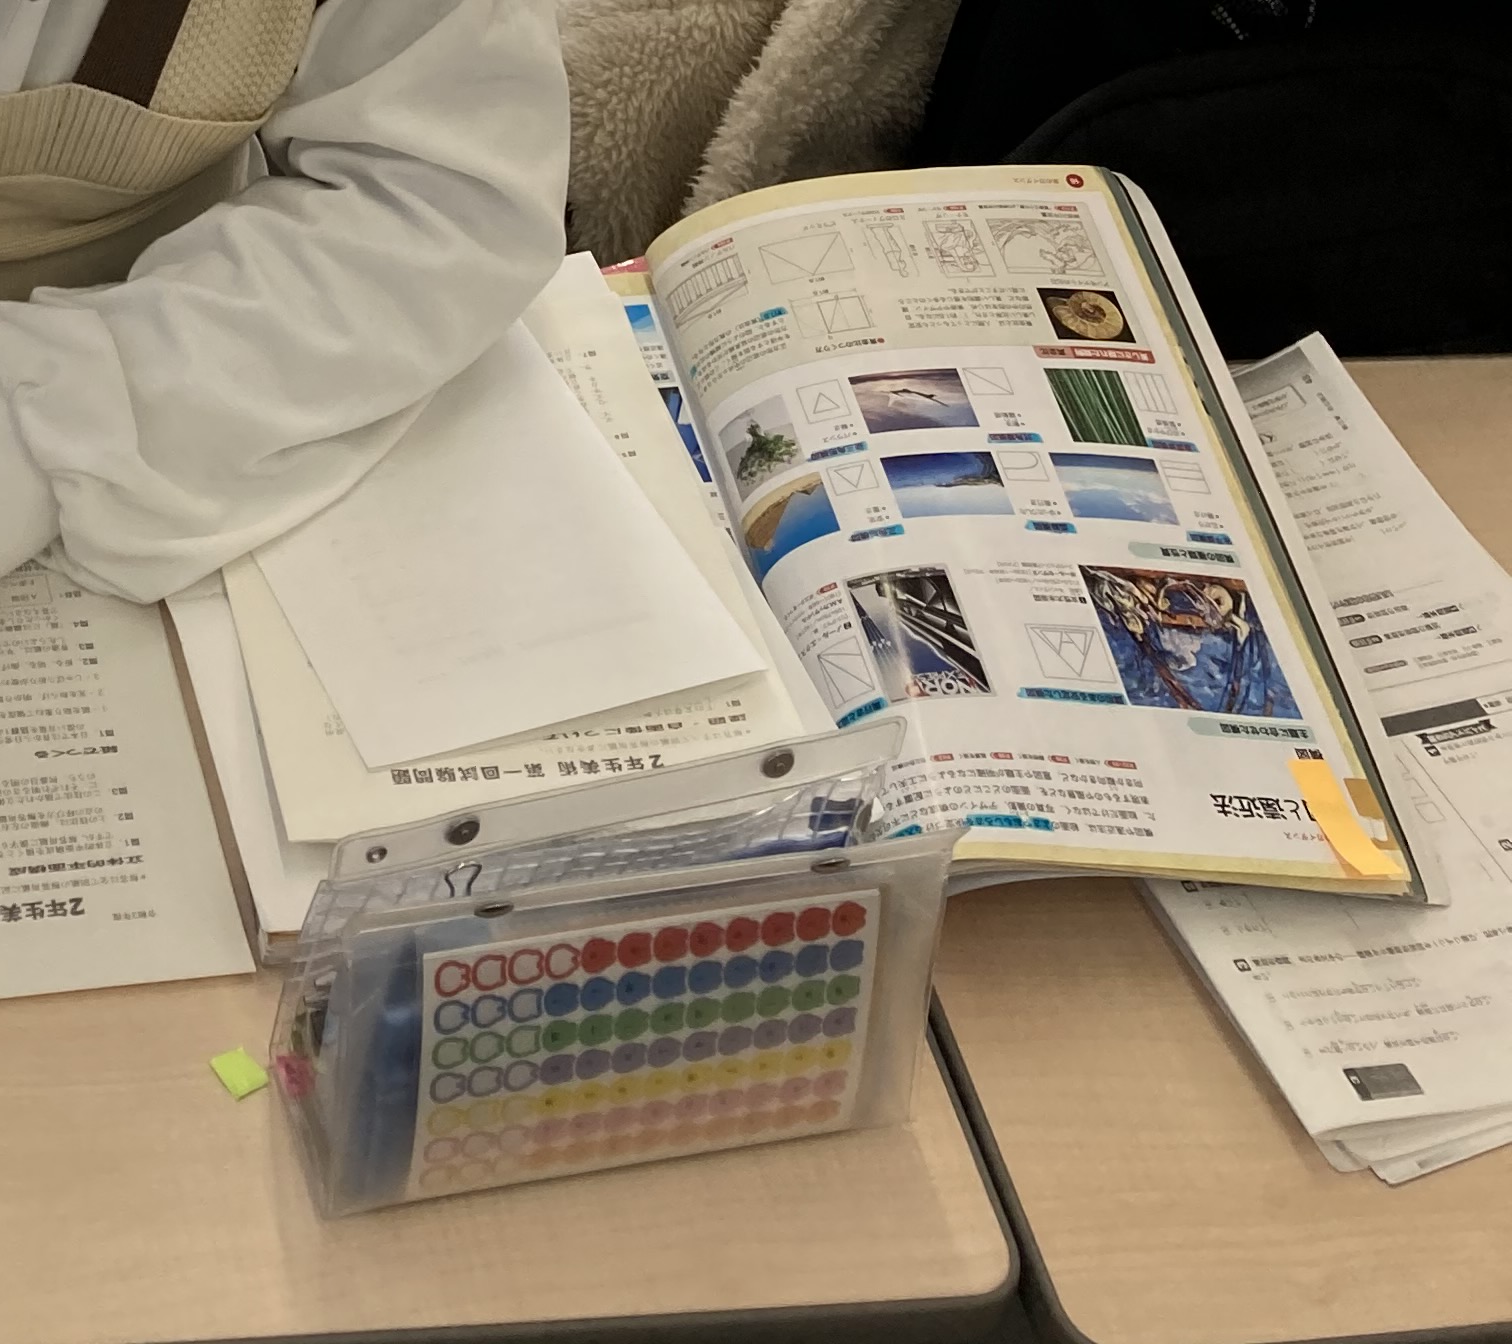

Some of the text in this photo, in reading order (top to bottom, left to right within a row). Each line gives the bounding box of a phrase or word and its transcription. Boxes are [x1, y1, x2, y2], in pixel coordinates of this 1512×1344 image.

[1159, 547, 1235, 564] 構図の種類と性質
[1219, 721, 1309, 740] 主題に合わせた構図
[34, 745, 119, 760] 紙でつくる
[1294, 747, 1325, 761] 構図
[389, 753, 665, 786] 2年生美術 第一回試験問題
[1209, 792, 1317, 823] と遠近法
[8, 854, 144, 877] 立体的平面構成
